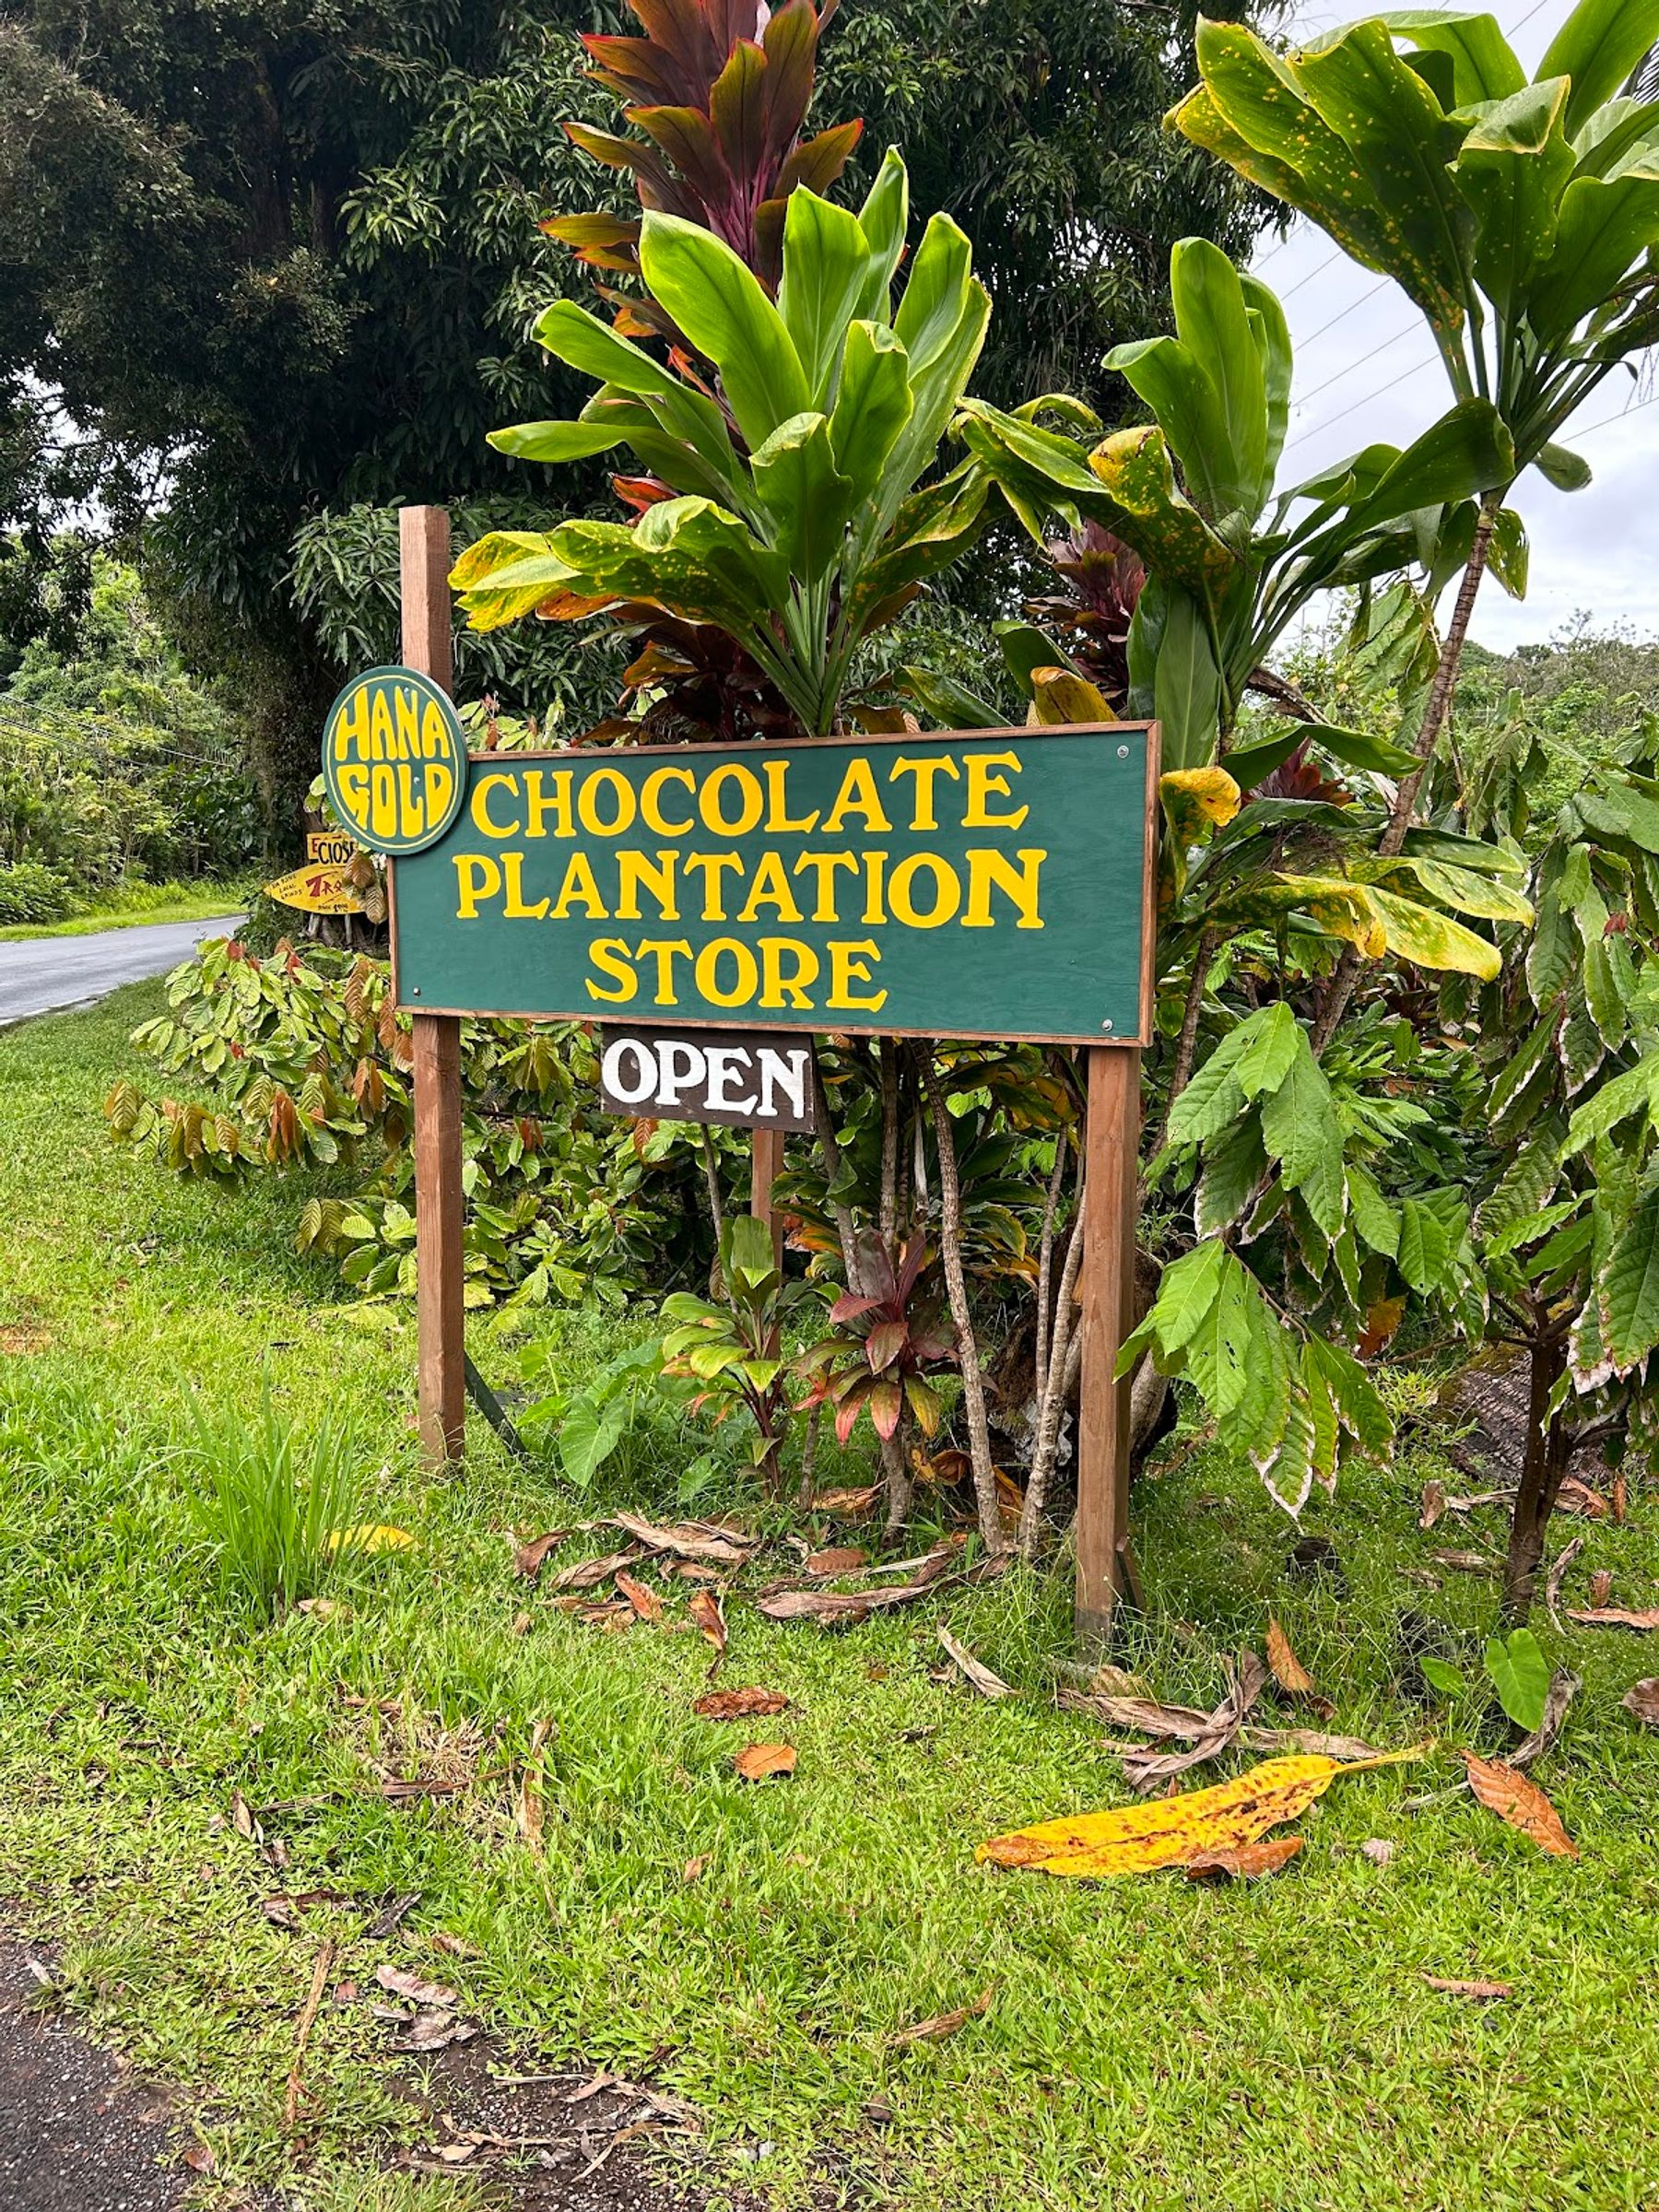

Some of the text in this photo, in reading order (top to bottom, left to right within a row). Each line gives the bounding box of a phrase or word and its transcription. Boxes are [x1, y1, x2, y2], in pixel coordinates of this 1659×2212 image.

[335, 686, 451, 761] HANA
[336, 763, 453, 838] GOLD
[471, 750, 1030, 839] CHOCOLATE
[452, 849, 1047, 929] PLANTATION
[585, 936, 888, 1013] STORE
[601, 1038, 809, 1119] OPEN
